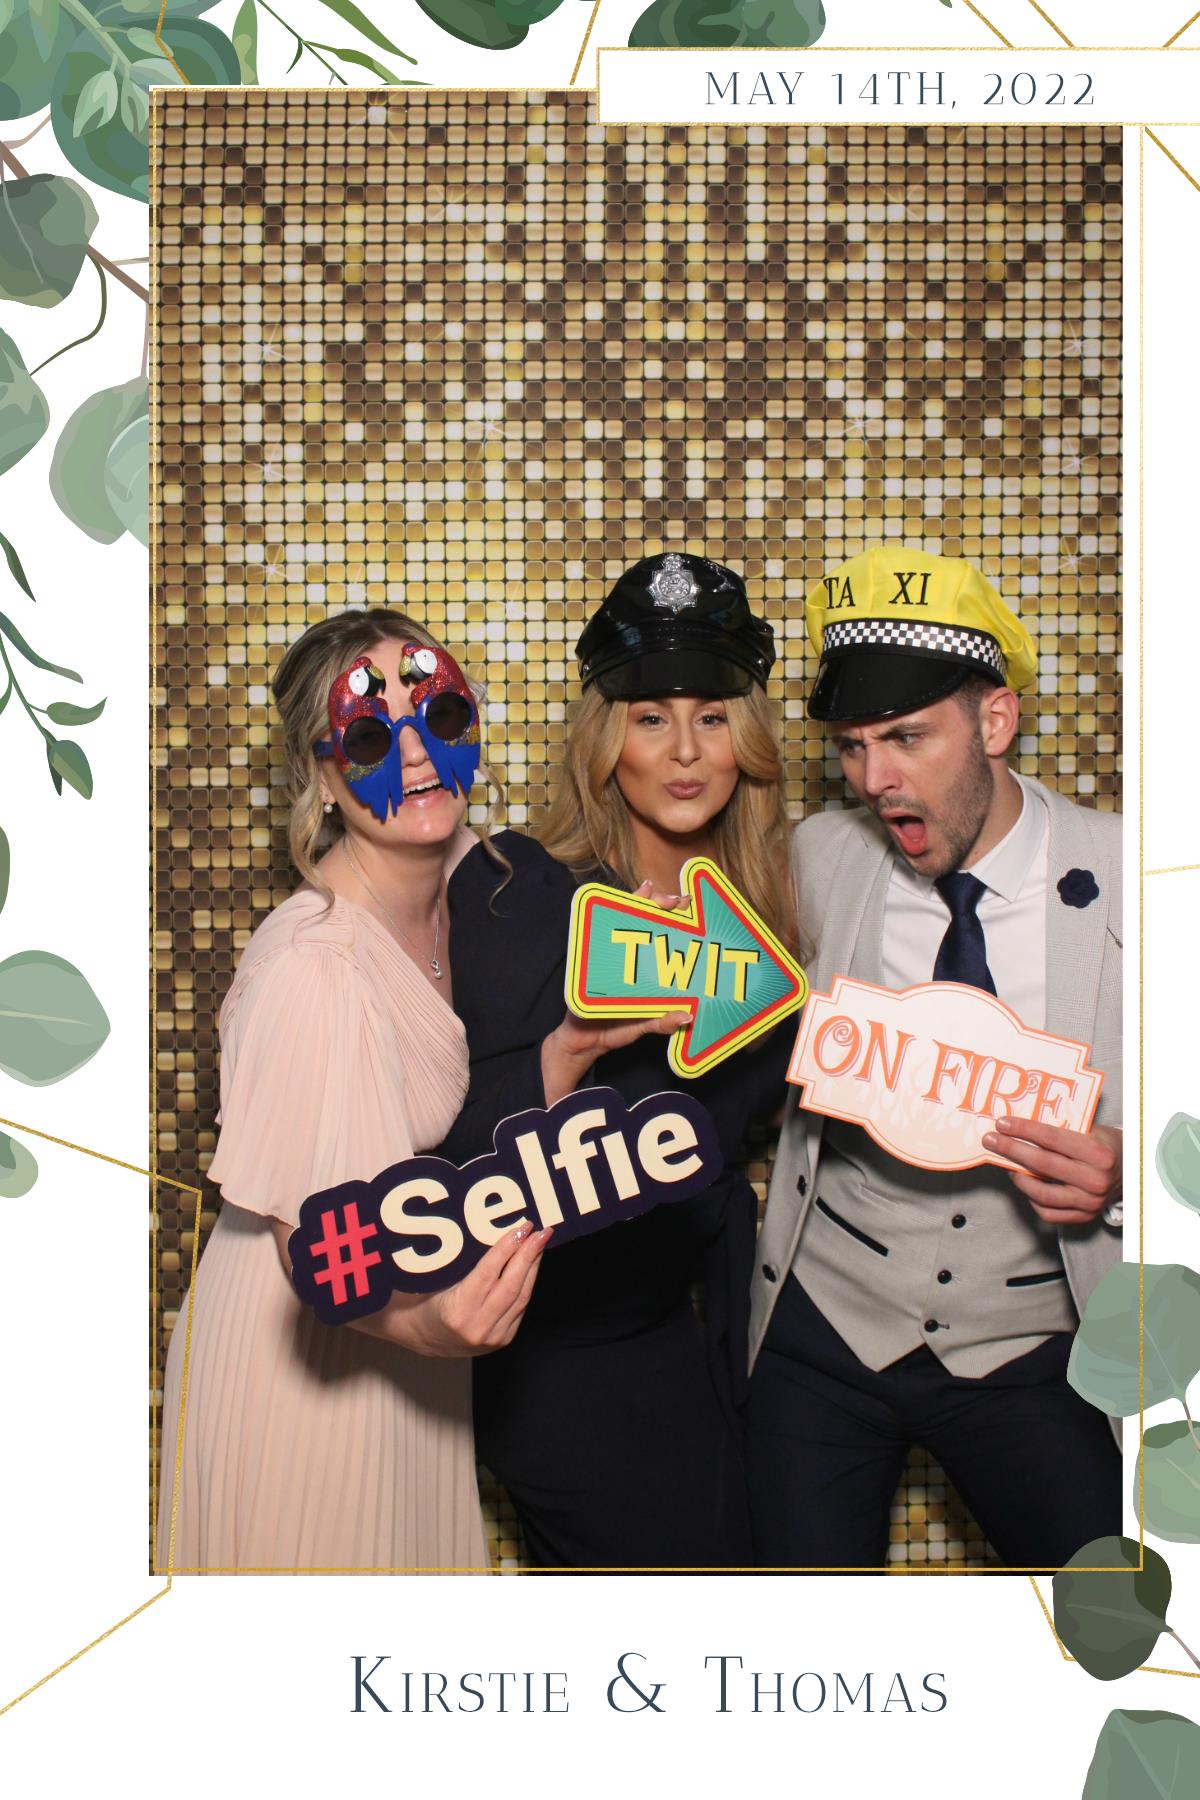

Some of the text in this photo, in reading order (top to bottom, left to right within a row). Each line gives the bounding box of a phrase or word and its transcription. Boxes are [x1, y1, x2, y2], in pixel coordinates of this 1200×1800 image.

[611, 928, 760, 1003] TWIT
[813, 1015, 1078, 1130] ON FIRE
[309, 1108, 704, 1306] #Selfie
